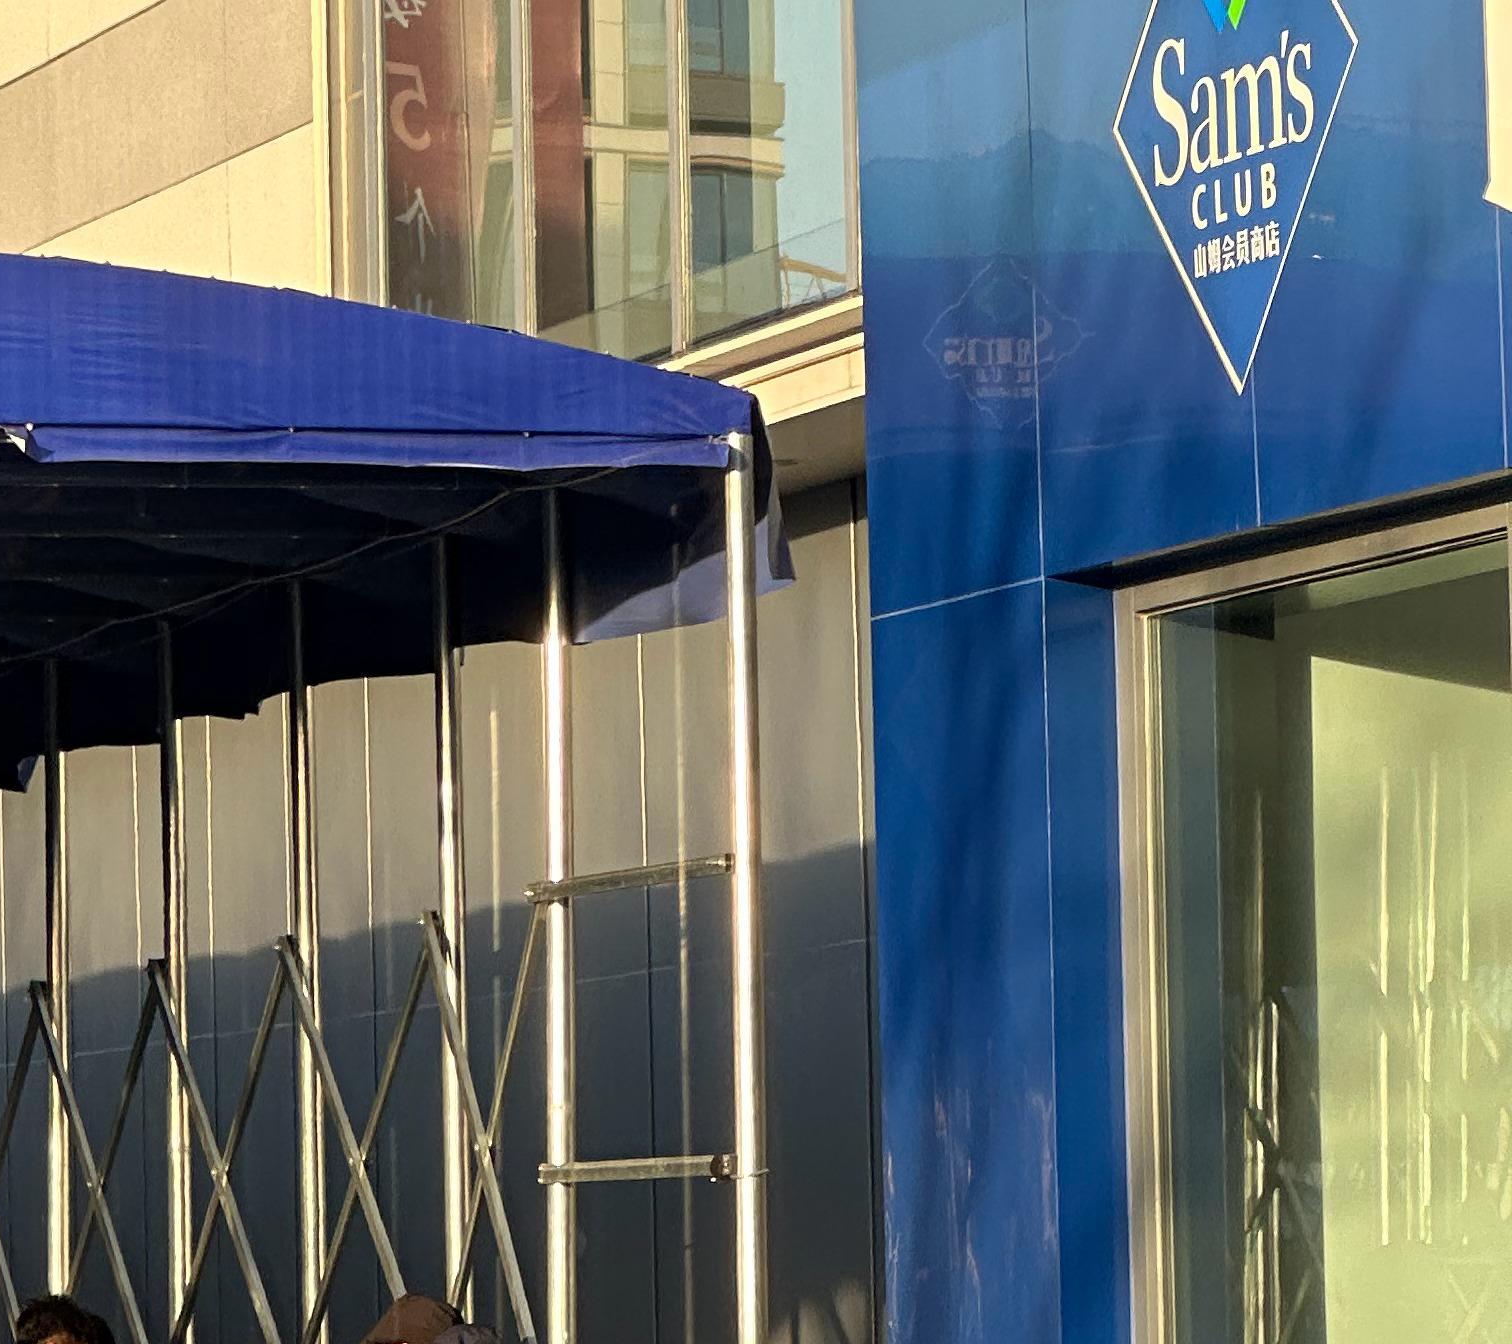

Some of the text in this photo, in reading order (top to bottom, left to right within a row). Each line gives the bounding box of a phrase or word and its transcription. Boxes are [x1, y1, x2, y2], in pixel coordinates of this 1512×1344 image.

[1152, 30, 1315, 186] Sam's
[1192, 163, 1277, 229] CLUB
[1194, 221, 1280, 278] 山姆会员商店
